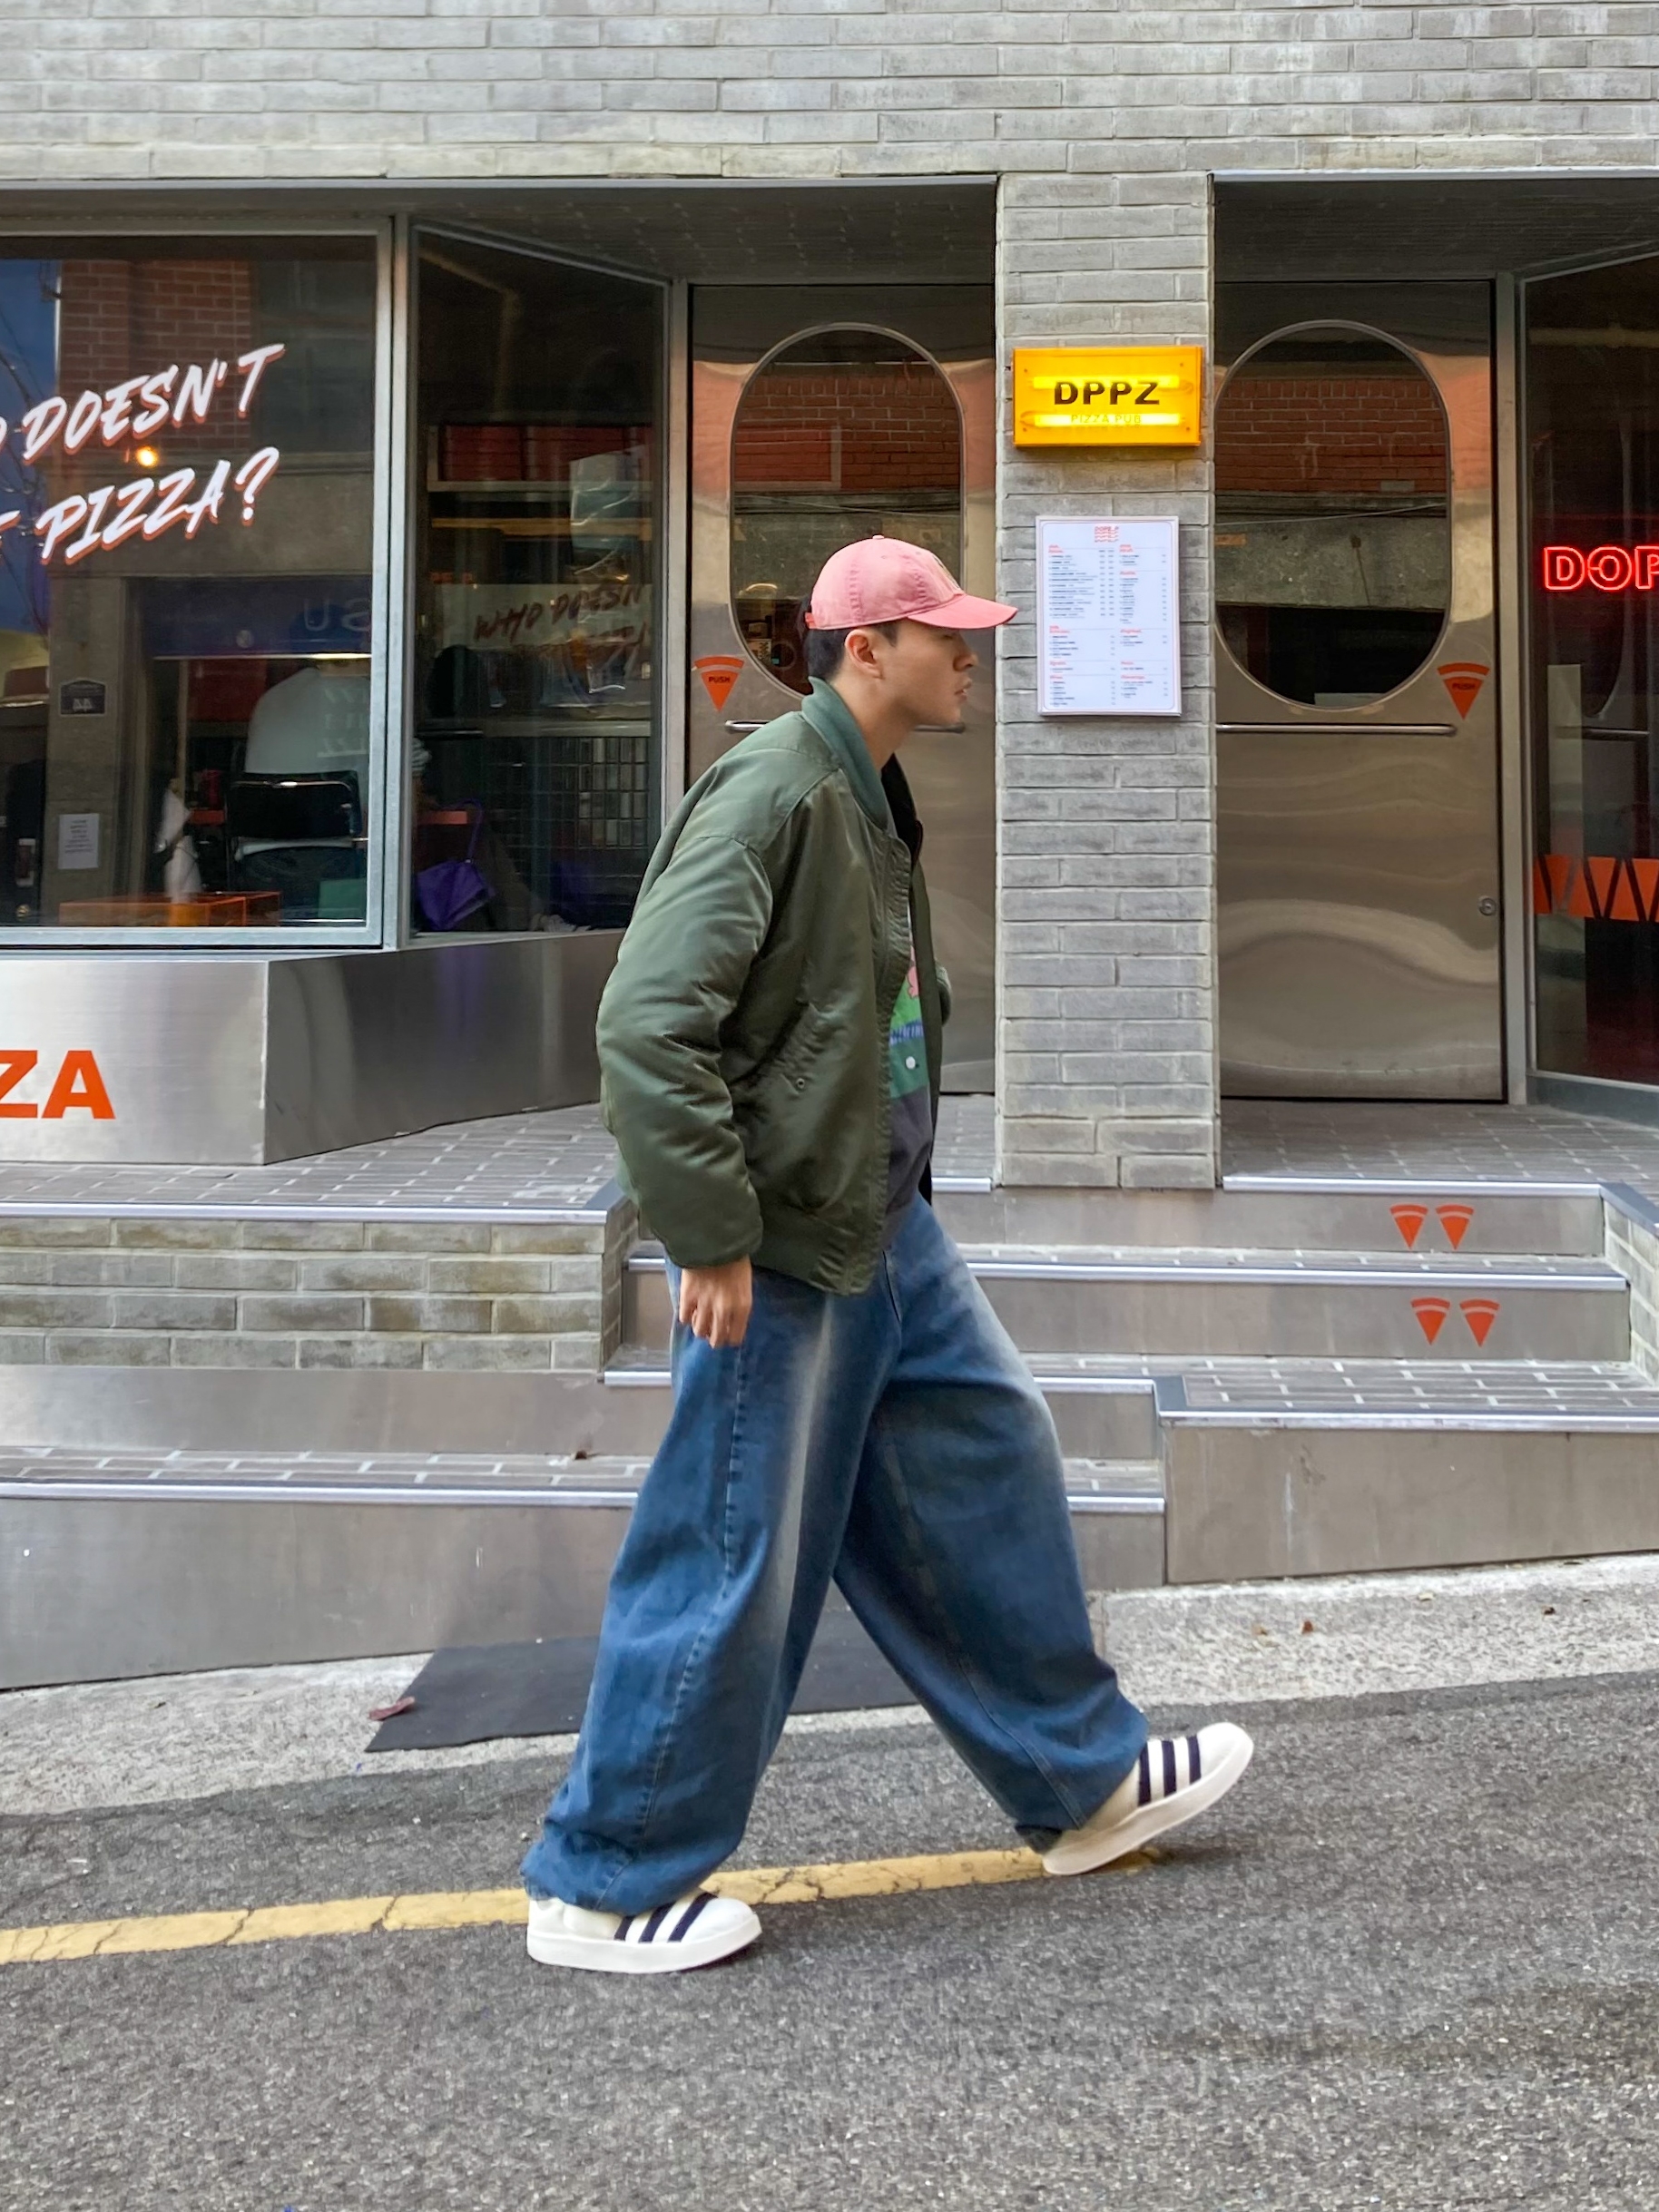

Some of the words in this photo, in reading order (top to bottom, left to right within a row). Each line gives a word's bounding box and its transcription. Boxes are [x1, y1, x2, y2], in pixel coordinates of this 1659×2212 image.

[22, 344, 285, 465] DOESN'T
[1054, 381, 1160, 406] DPPZ
[1071, 414, 1110, 424] PIZZA
[1115, 414, 1142, 424] PUB
[34, 446, 280, 564] PIZZA?
[1543, 546, 1659, 591] DOP
[0, 1050, 116, 1120] ZA
